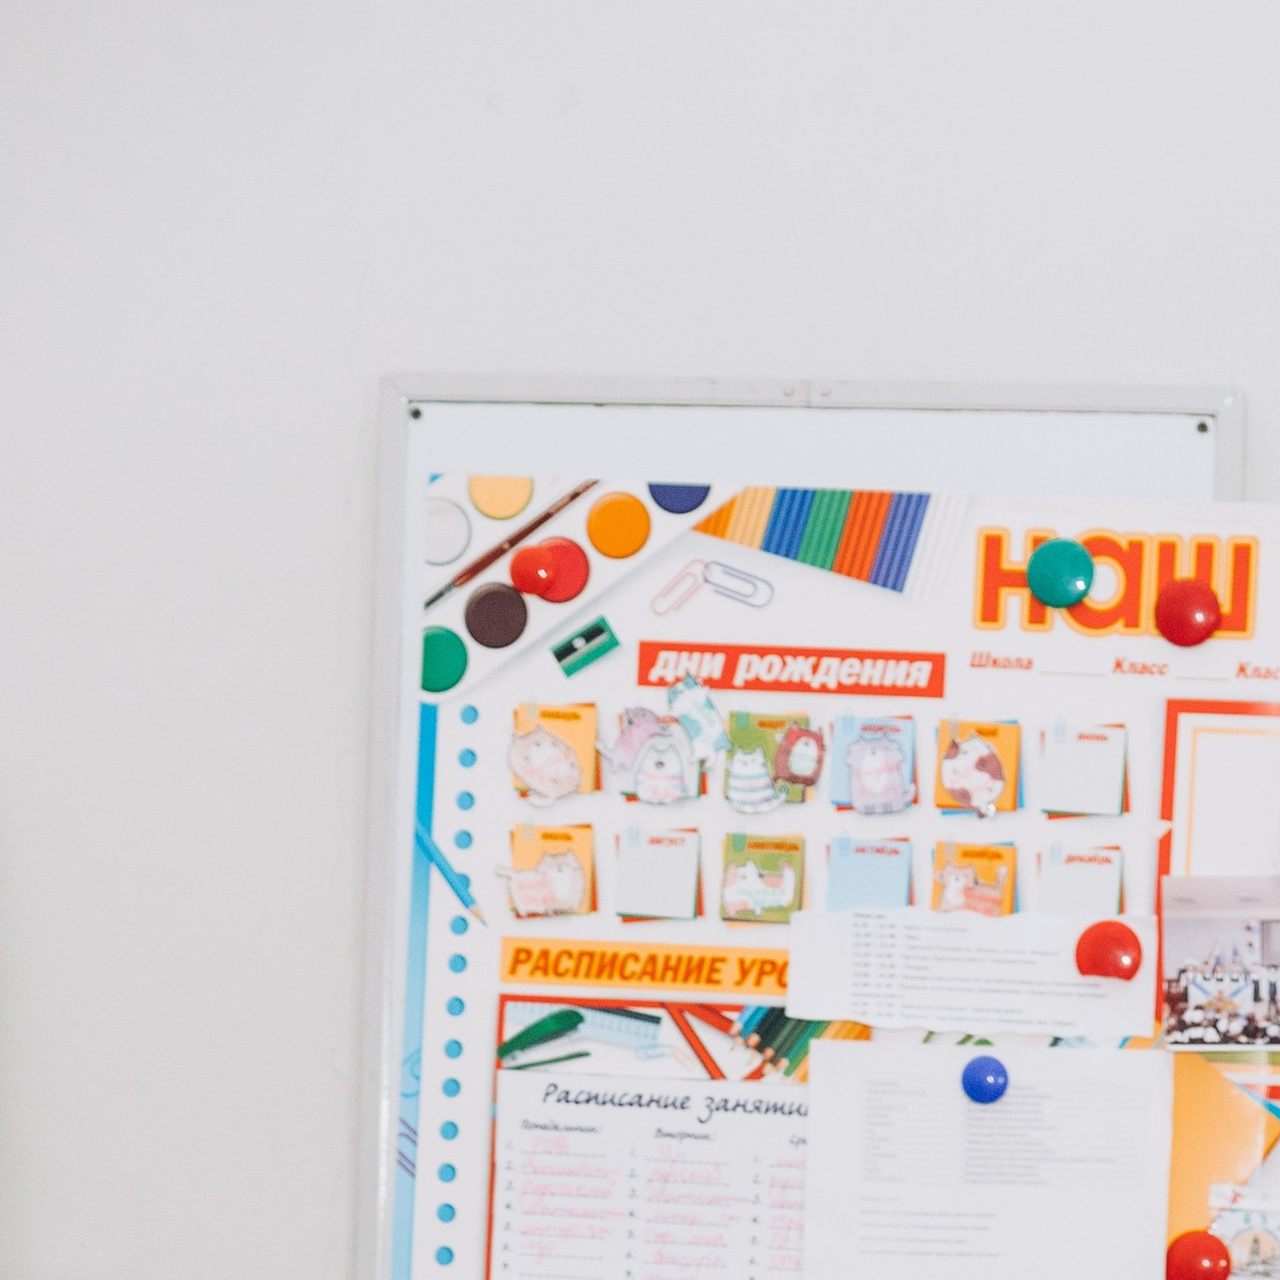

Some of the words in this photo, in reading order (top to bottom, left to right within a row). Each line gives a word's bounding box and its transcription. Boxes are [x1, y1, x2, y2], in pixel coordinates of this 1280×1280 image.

[648, 649, 725, 683] дни
[733, 651, 934, 690] рождения
[969, 650, 1034, 672] Школа
[1113, 656, 1170, 676] Класс
[507, 945, 728, 985] РАСПИСАНИЕ
[541, 1082, 691, 1111] Расписание
